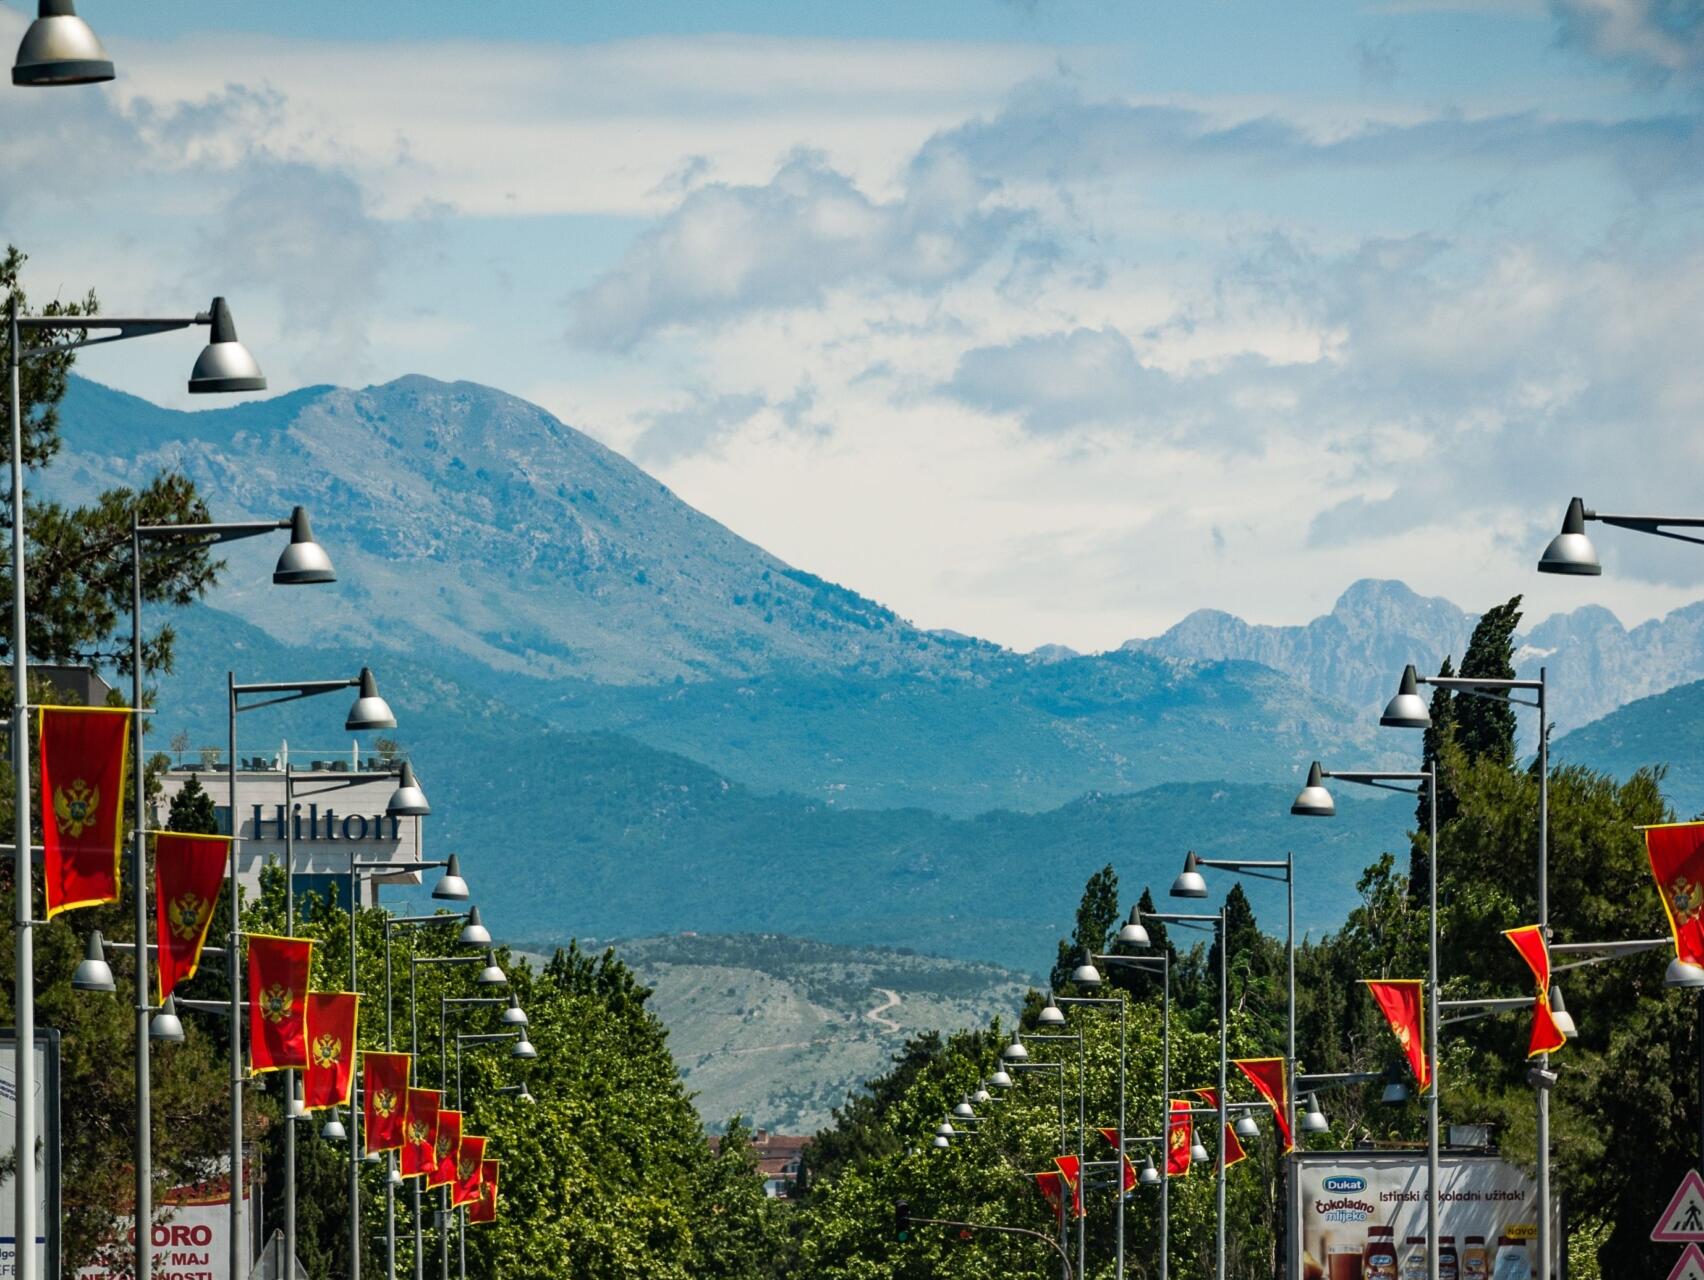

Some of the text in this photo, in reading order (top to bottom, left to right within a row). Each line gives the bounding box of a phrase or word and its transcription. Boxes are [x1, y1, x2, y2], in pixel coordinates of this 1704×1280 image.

[252, 803, 402, 841] Hilton
[1328, 1181, 1362, 1190] Dukat
[1379, 1190, 1525, 1202] Istinski čkoladni užitak!
[1325, 1210, 1367, 1223] mlijeko
[172, 1253, 209, 1265] MAJ
